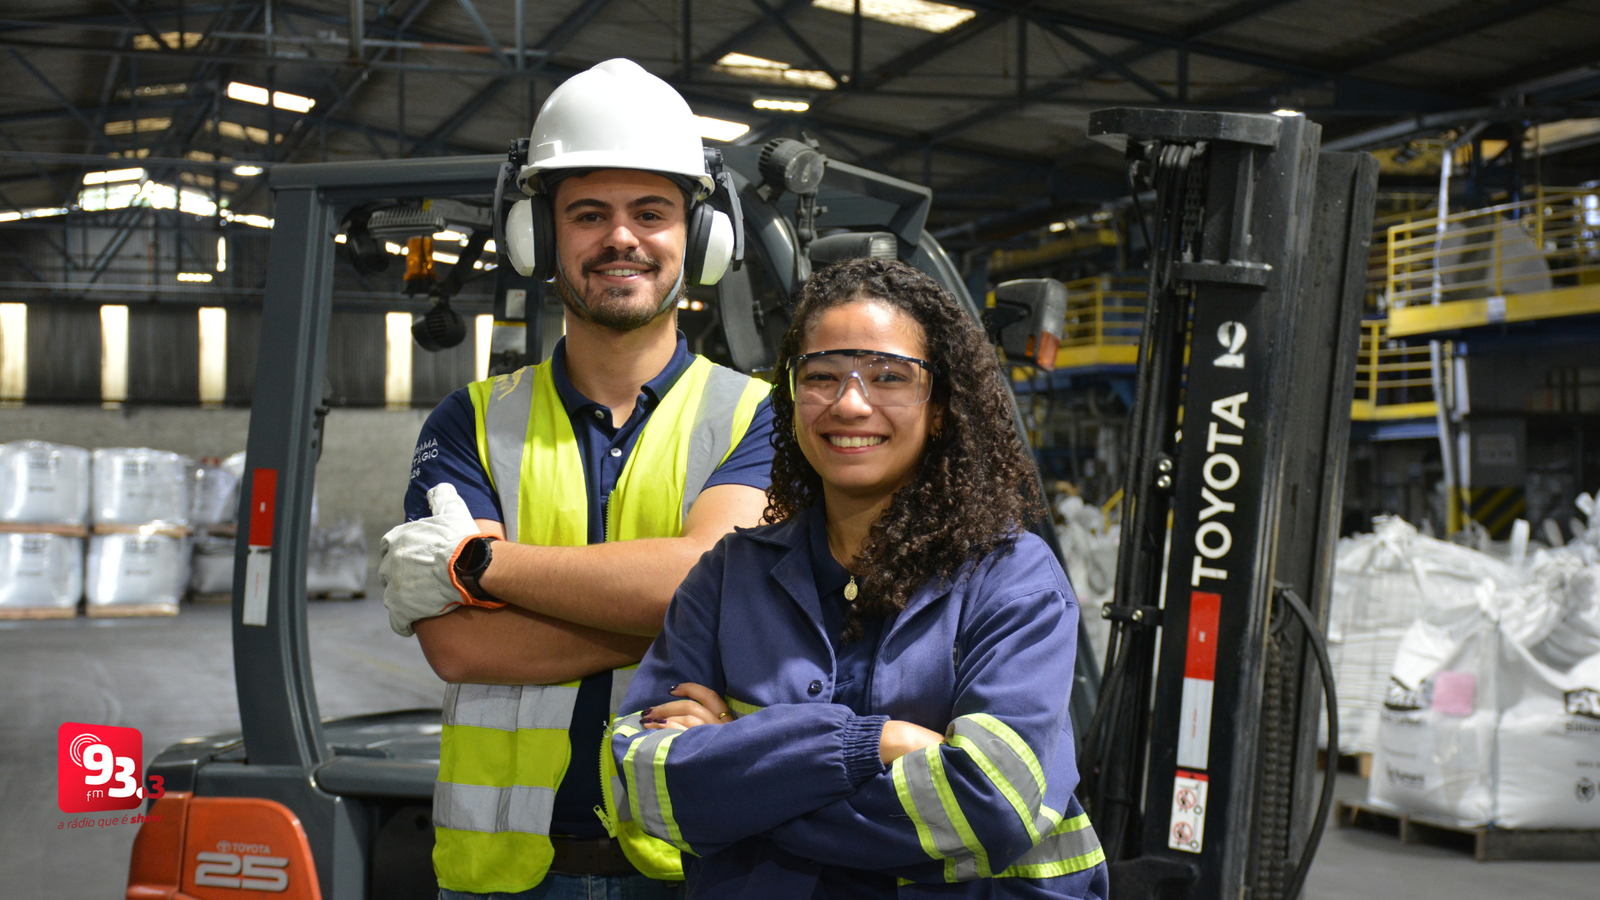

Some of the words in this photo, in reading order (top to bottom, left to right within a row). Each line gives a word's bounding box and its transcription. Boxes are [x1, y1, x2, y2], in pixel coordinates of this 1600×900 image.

[1191, 391, 1249, 587] TOYOTA
[232, 842, 271, 855] TOYOTA
[194, 851, 290, 893] 25
